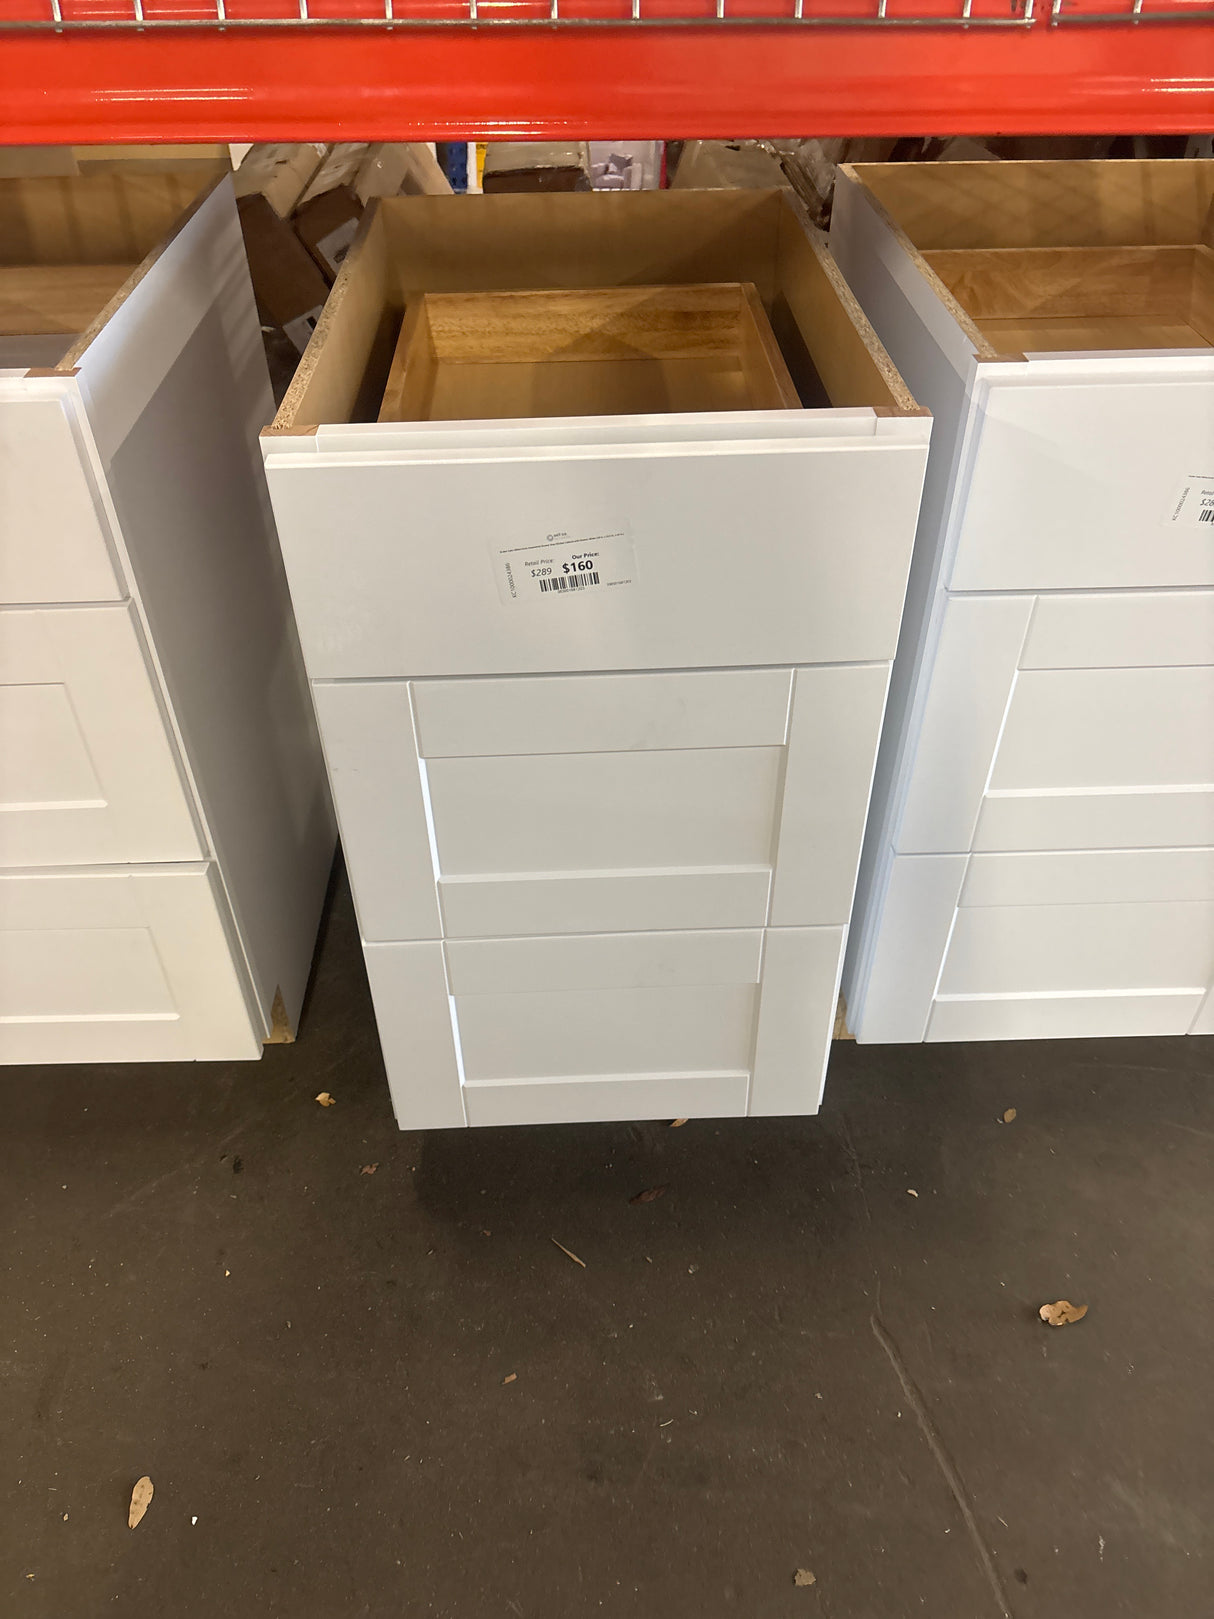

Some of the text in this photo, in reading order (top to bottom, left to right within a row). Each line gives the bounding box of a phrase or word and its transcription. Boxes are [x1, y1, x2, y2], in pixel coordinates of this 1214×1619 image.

[583, 551, 600, 559] Price:
[524, 559, 540, 567] Retail
[562, 559, 594, 574] $160
[531, 567, 553, 578] $289
